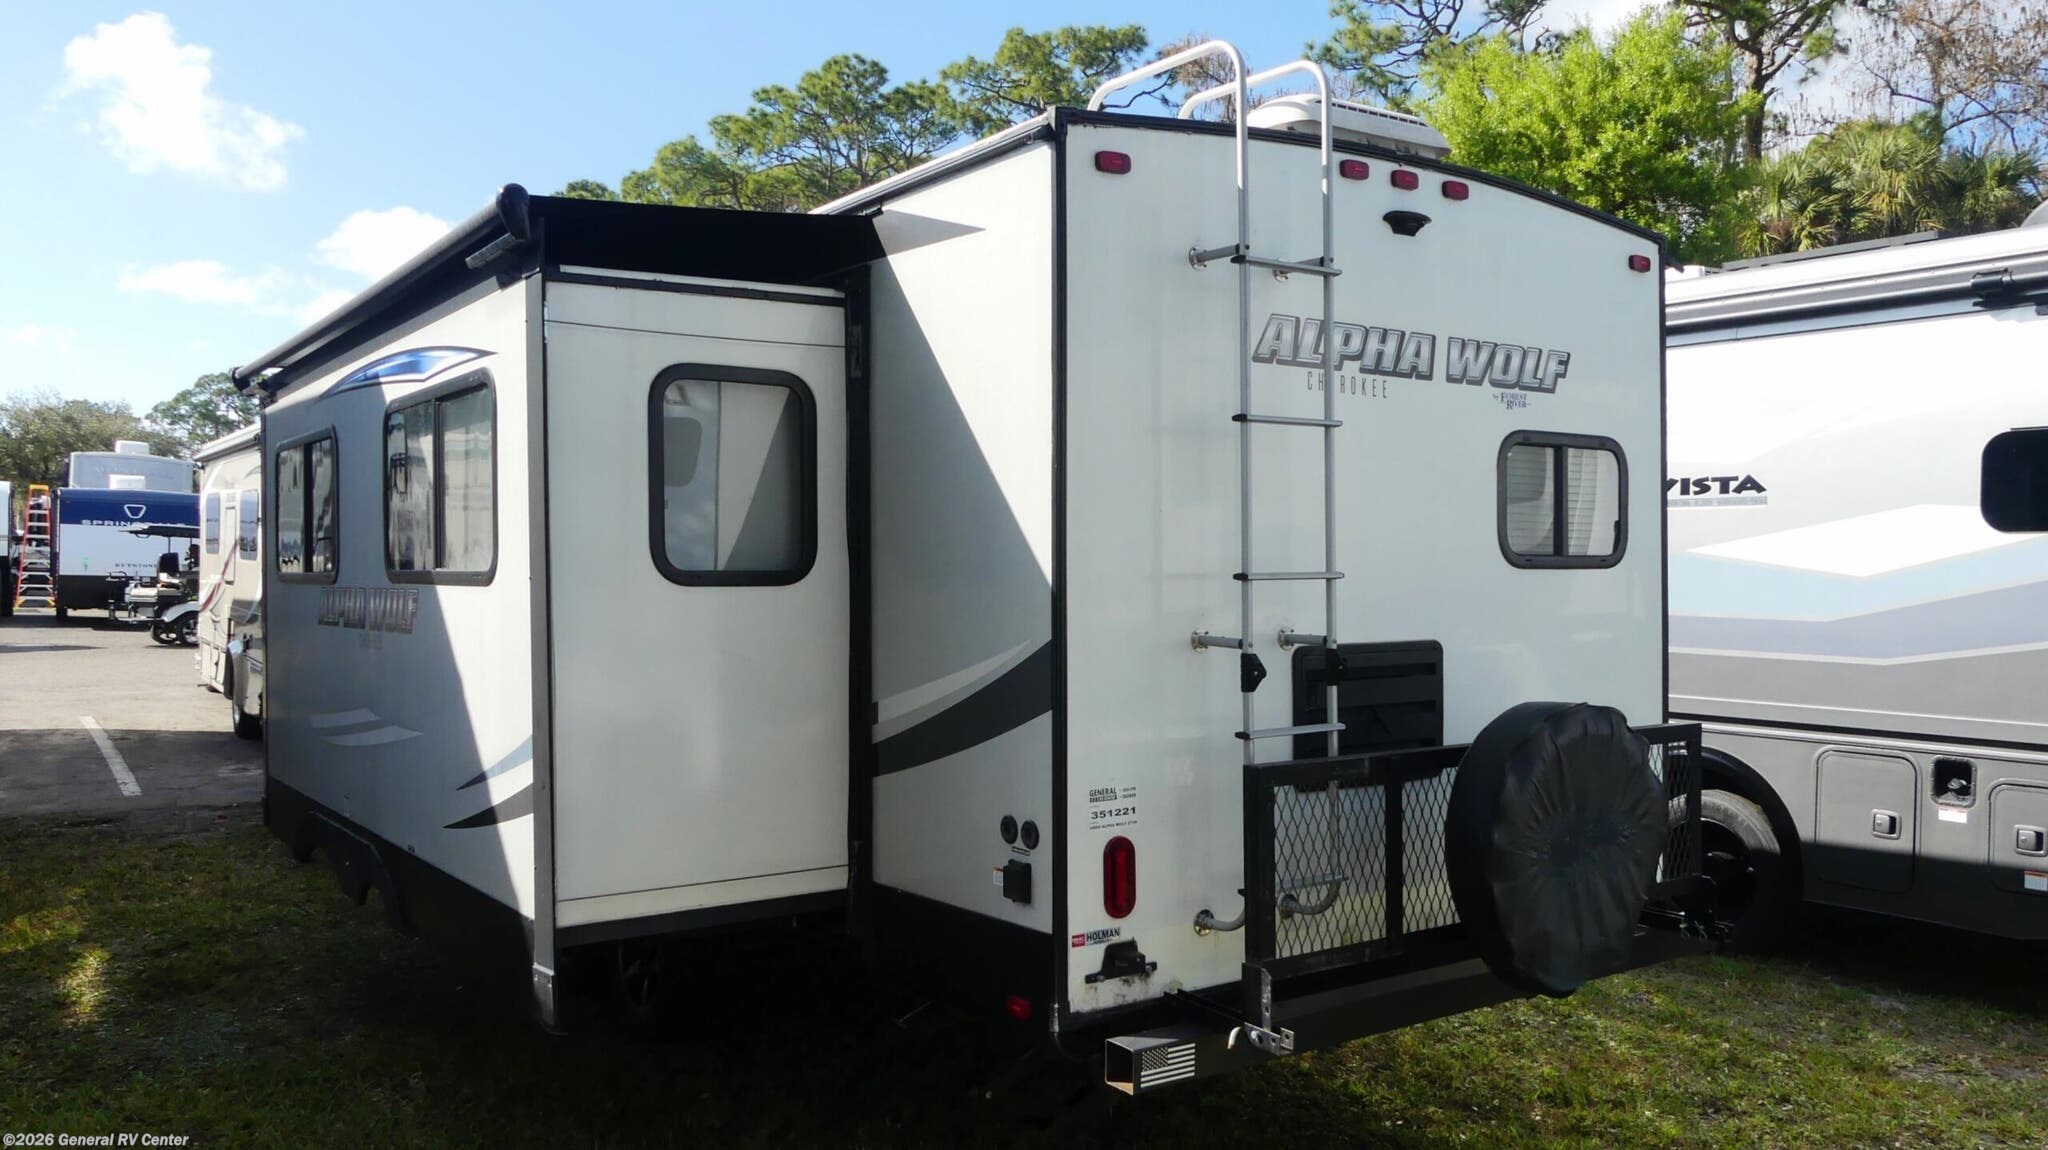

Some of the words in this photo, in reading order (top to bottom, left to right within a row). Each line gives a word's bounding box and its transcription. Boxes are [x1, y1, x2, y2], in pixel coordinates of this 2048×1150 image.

[1252, 313, 1436, 380] ALPHA
[1446, 336, 1571, 393] WOLF
[1307, 370, 1388, 399] CHROKEE
[1089, 786, 1117, 797] GENERAL
[1091, 806, 1136, 820] 351221
[1086, 928, 1120, 942] HOLMAN
